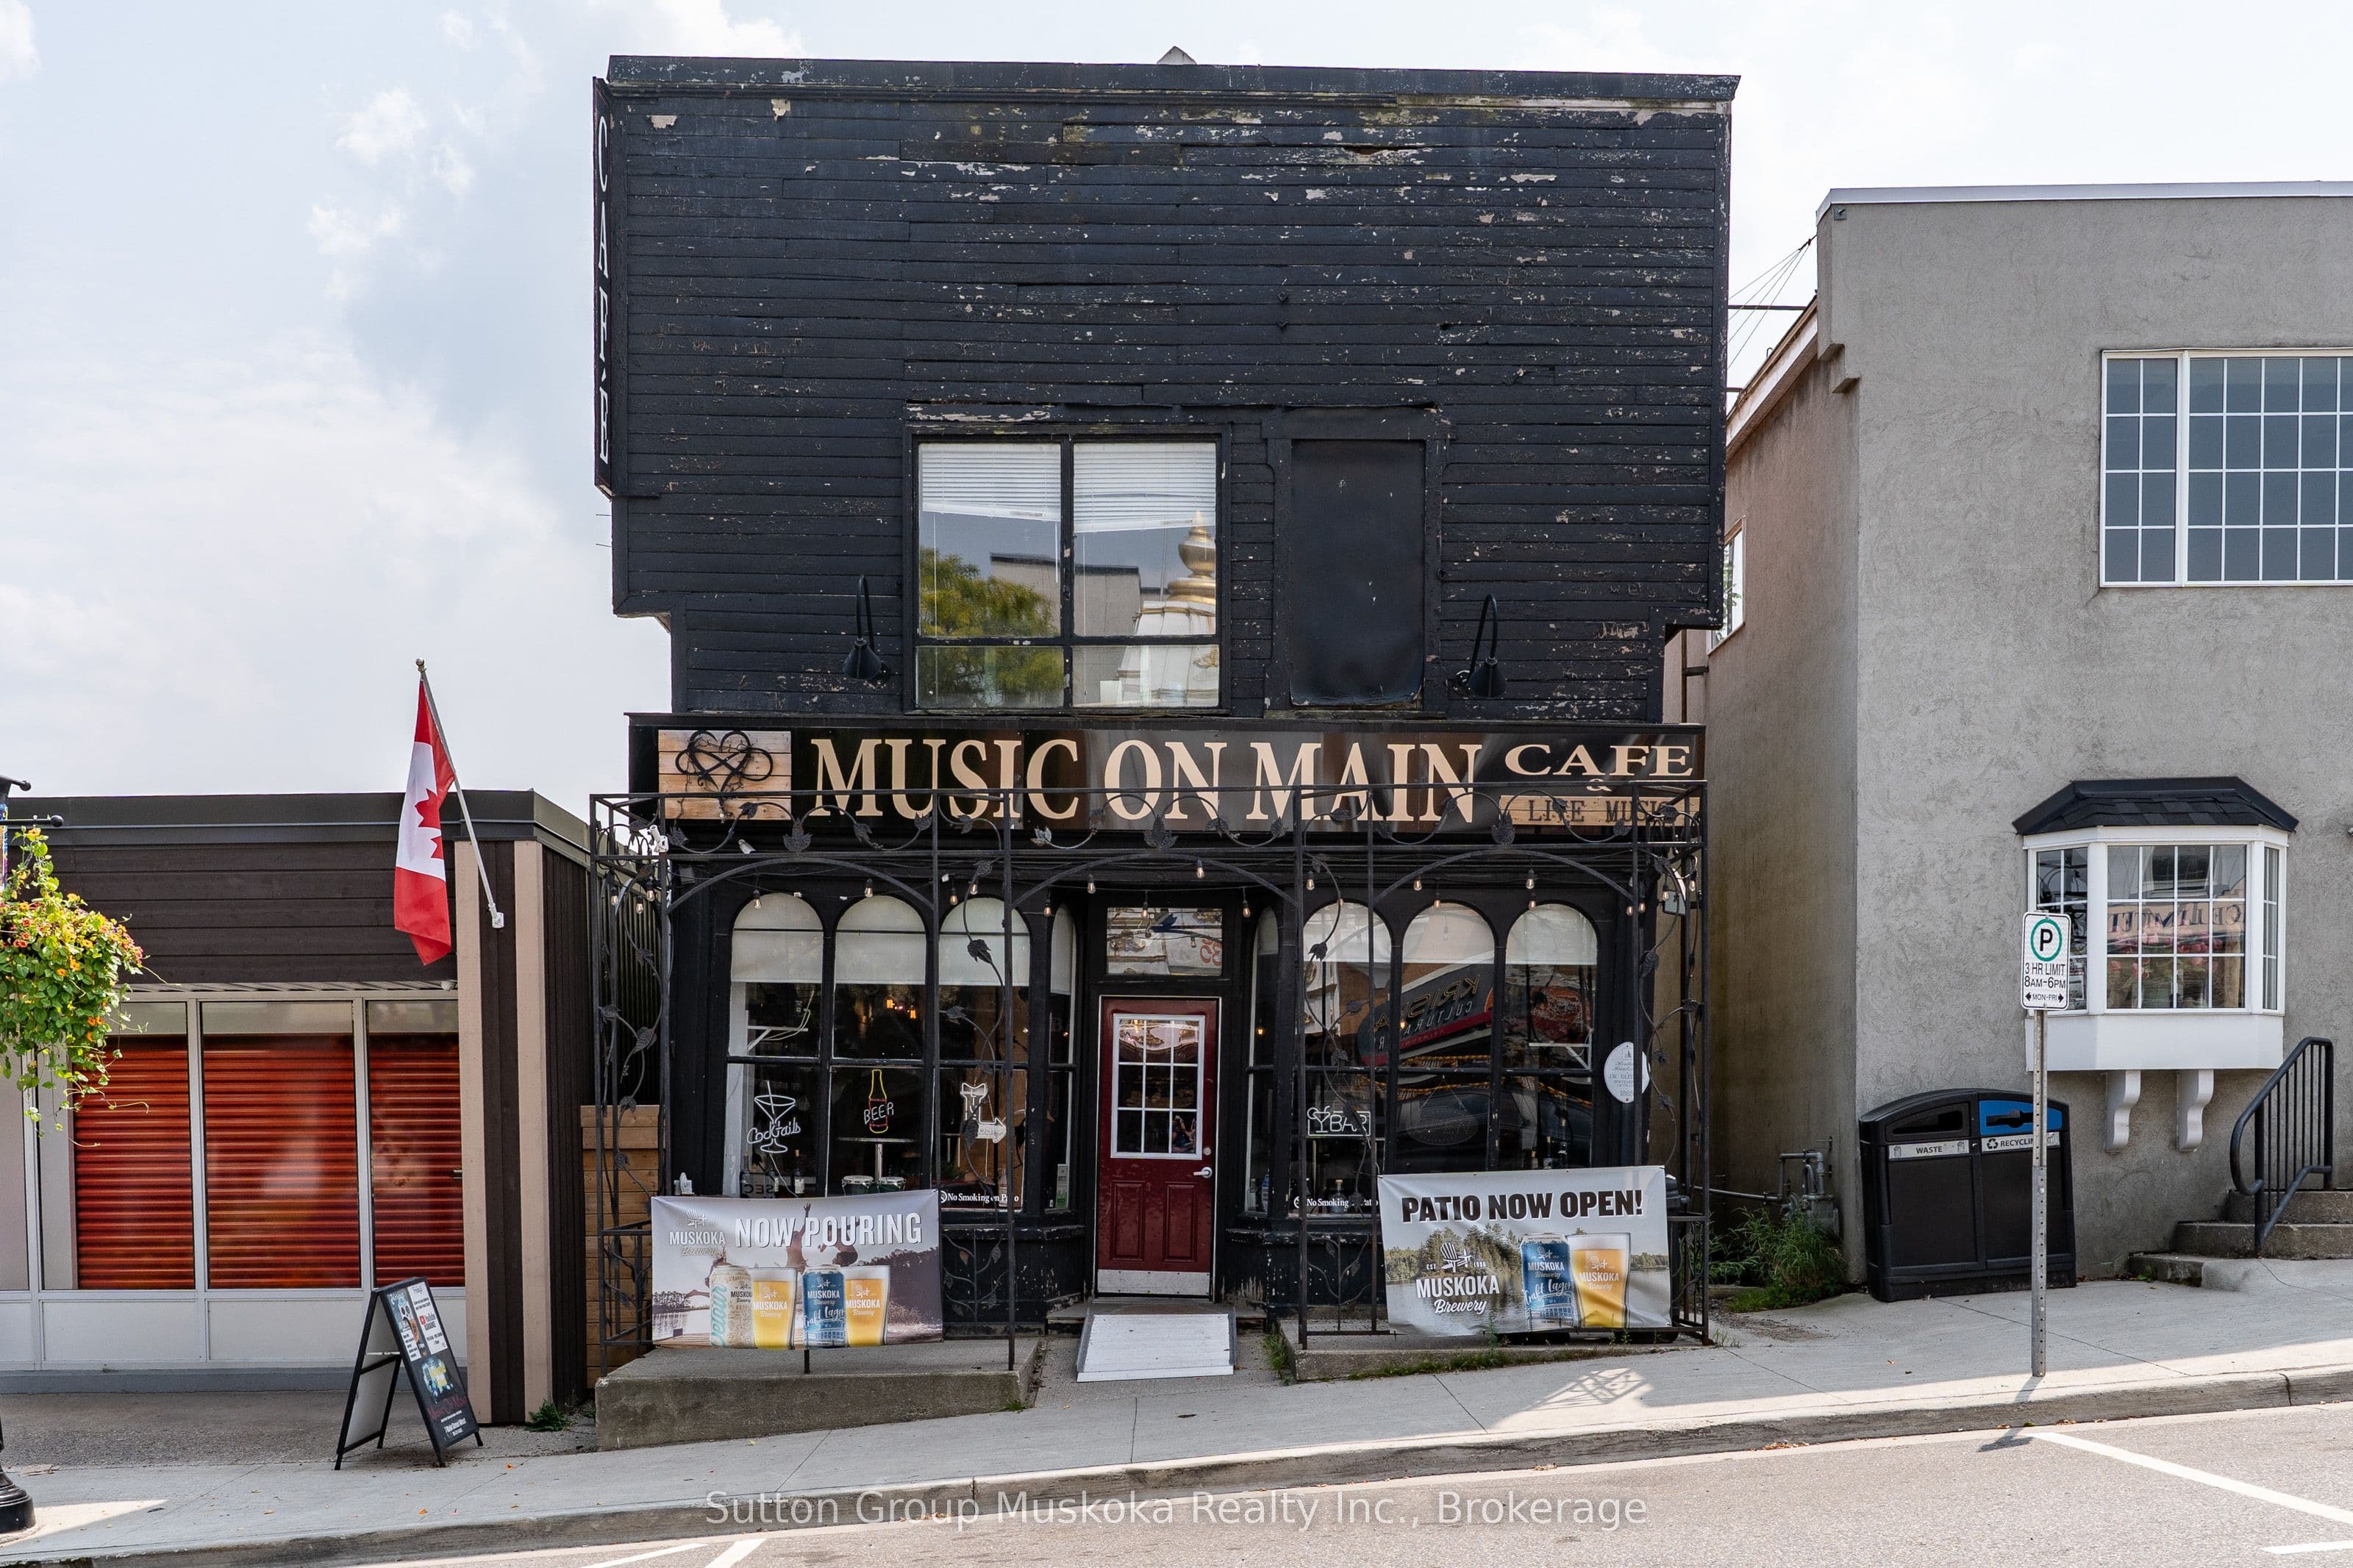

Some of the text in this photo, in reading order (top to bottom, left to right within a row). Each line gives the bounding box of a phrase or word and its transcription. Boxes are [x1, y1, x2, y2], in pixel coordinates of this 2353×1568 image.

[1504, 744, 1693, 776] CAFE
[807, 738, 1483, 825] MUSIC ON MAIN
[2039, 928, 2053, 952] P
[2025, 962, 2065, 976] 3 HR LIMIT
[2024, 975, 2065, 989] 8AM-6PM
[863, 1101, 894, 1125] BEER
[2000, 1137, 2034, 1148] RECYCLIN
[1915, 1146, 1943, 1154] WASTE
[947, 1193, 957, 1201] No
[958, 1193, 990, 1204] Smoking
[1306, 1198, 1316, 1206] No
[1317, 1198, 1349, 1208] Smoking
[1402, 1189, 1643, 1222] PATIO NOW OPEN!
[735, 1212, 922, 1248] NOW POURING
[669, 1231, 726, 1245] MUSKOKA
[1528, 1261, 1565, 1271] MUSKOKA
[1579, 1272, 1619, 1282] MUSKOKA
[1415, 1275, 1500, 1298] MUSKOKA
[807, 1290, 840, 1299] MUSKOKA
[753, 1301, 788, 1311] MUSKOKA
[846, 1299, 880, 1309] MUSKOKA
[1434, 1298, 1487, 1315] Brewery
